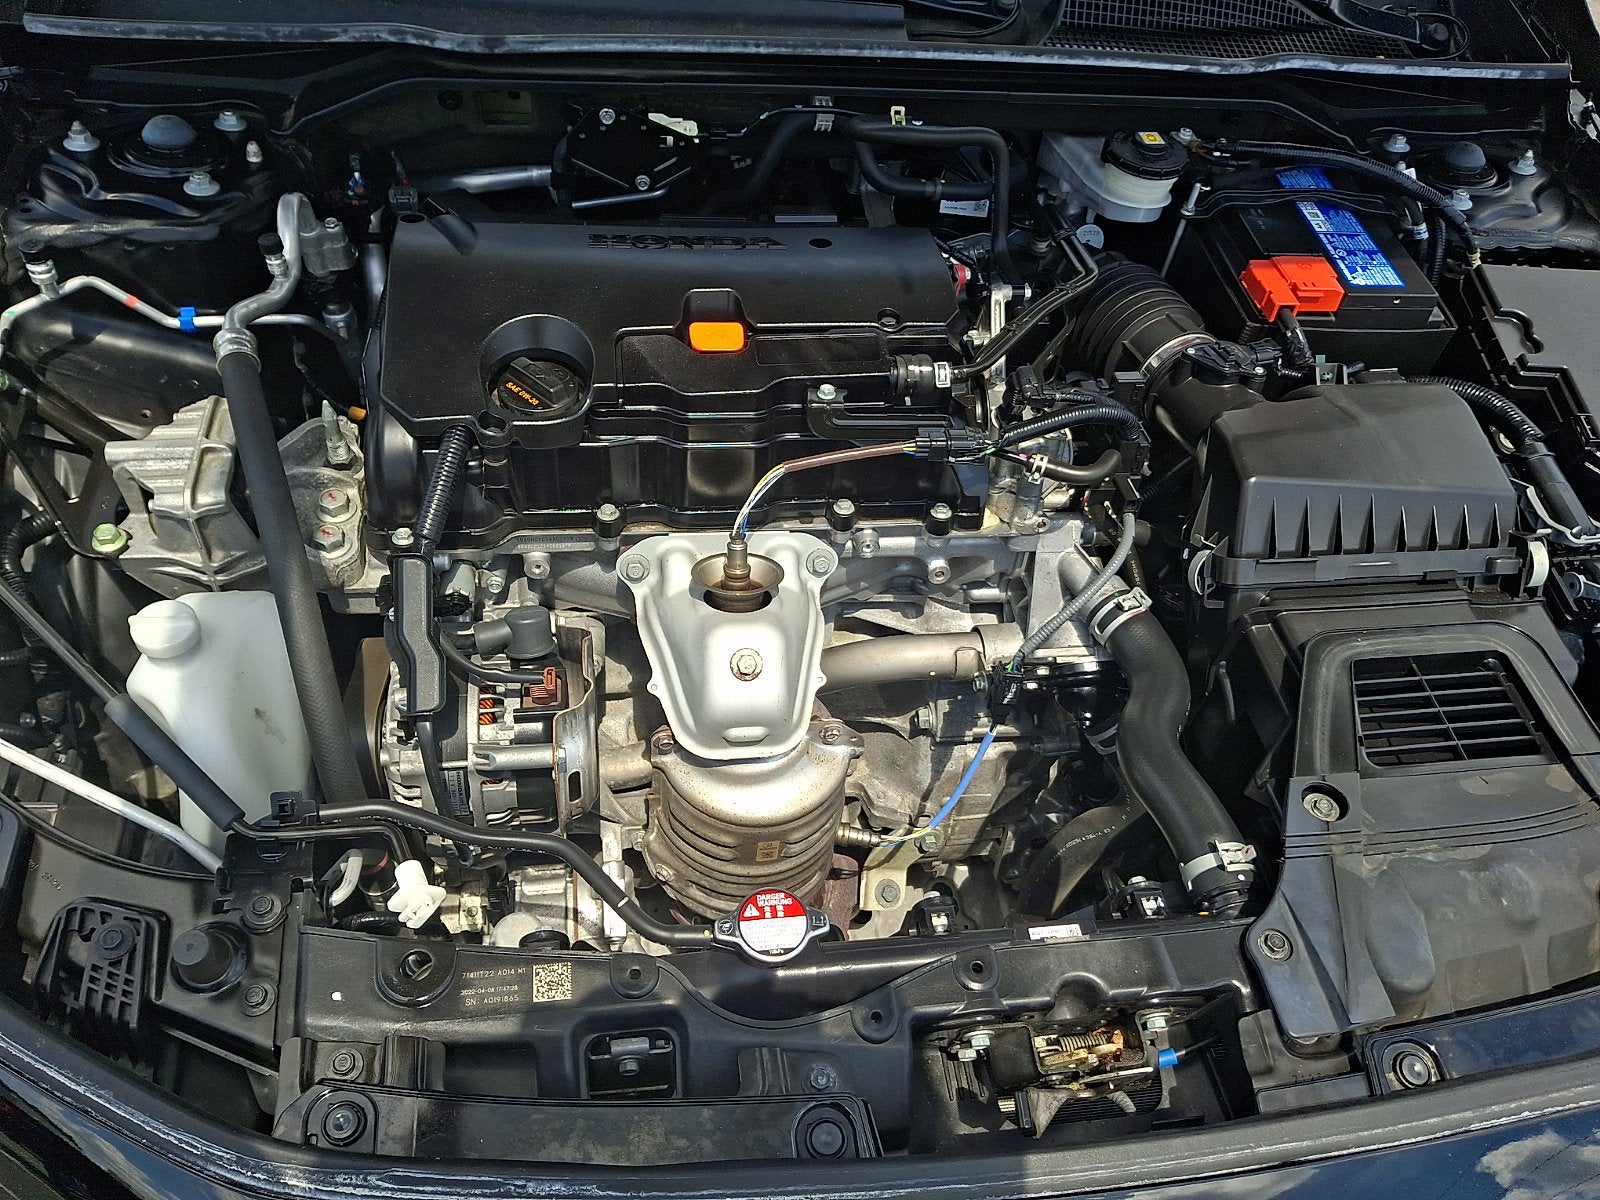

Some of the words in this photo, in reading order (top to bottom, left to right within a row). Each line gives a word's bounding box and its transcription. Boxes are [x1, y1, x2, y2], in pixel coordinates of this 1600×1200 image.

[587, 233, 788, 250] HONDA
[505, 382, 522, 393] SAE
[518, 390, 540, 406] 0W-20
[756, 892, 785, 901] DANGER
